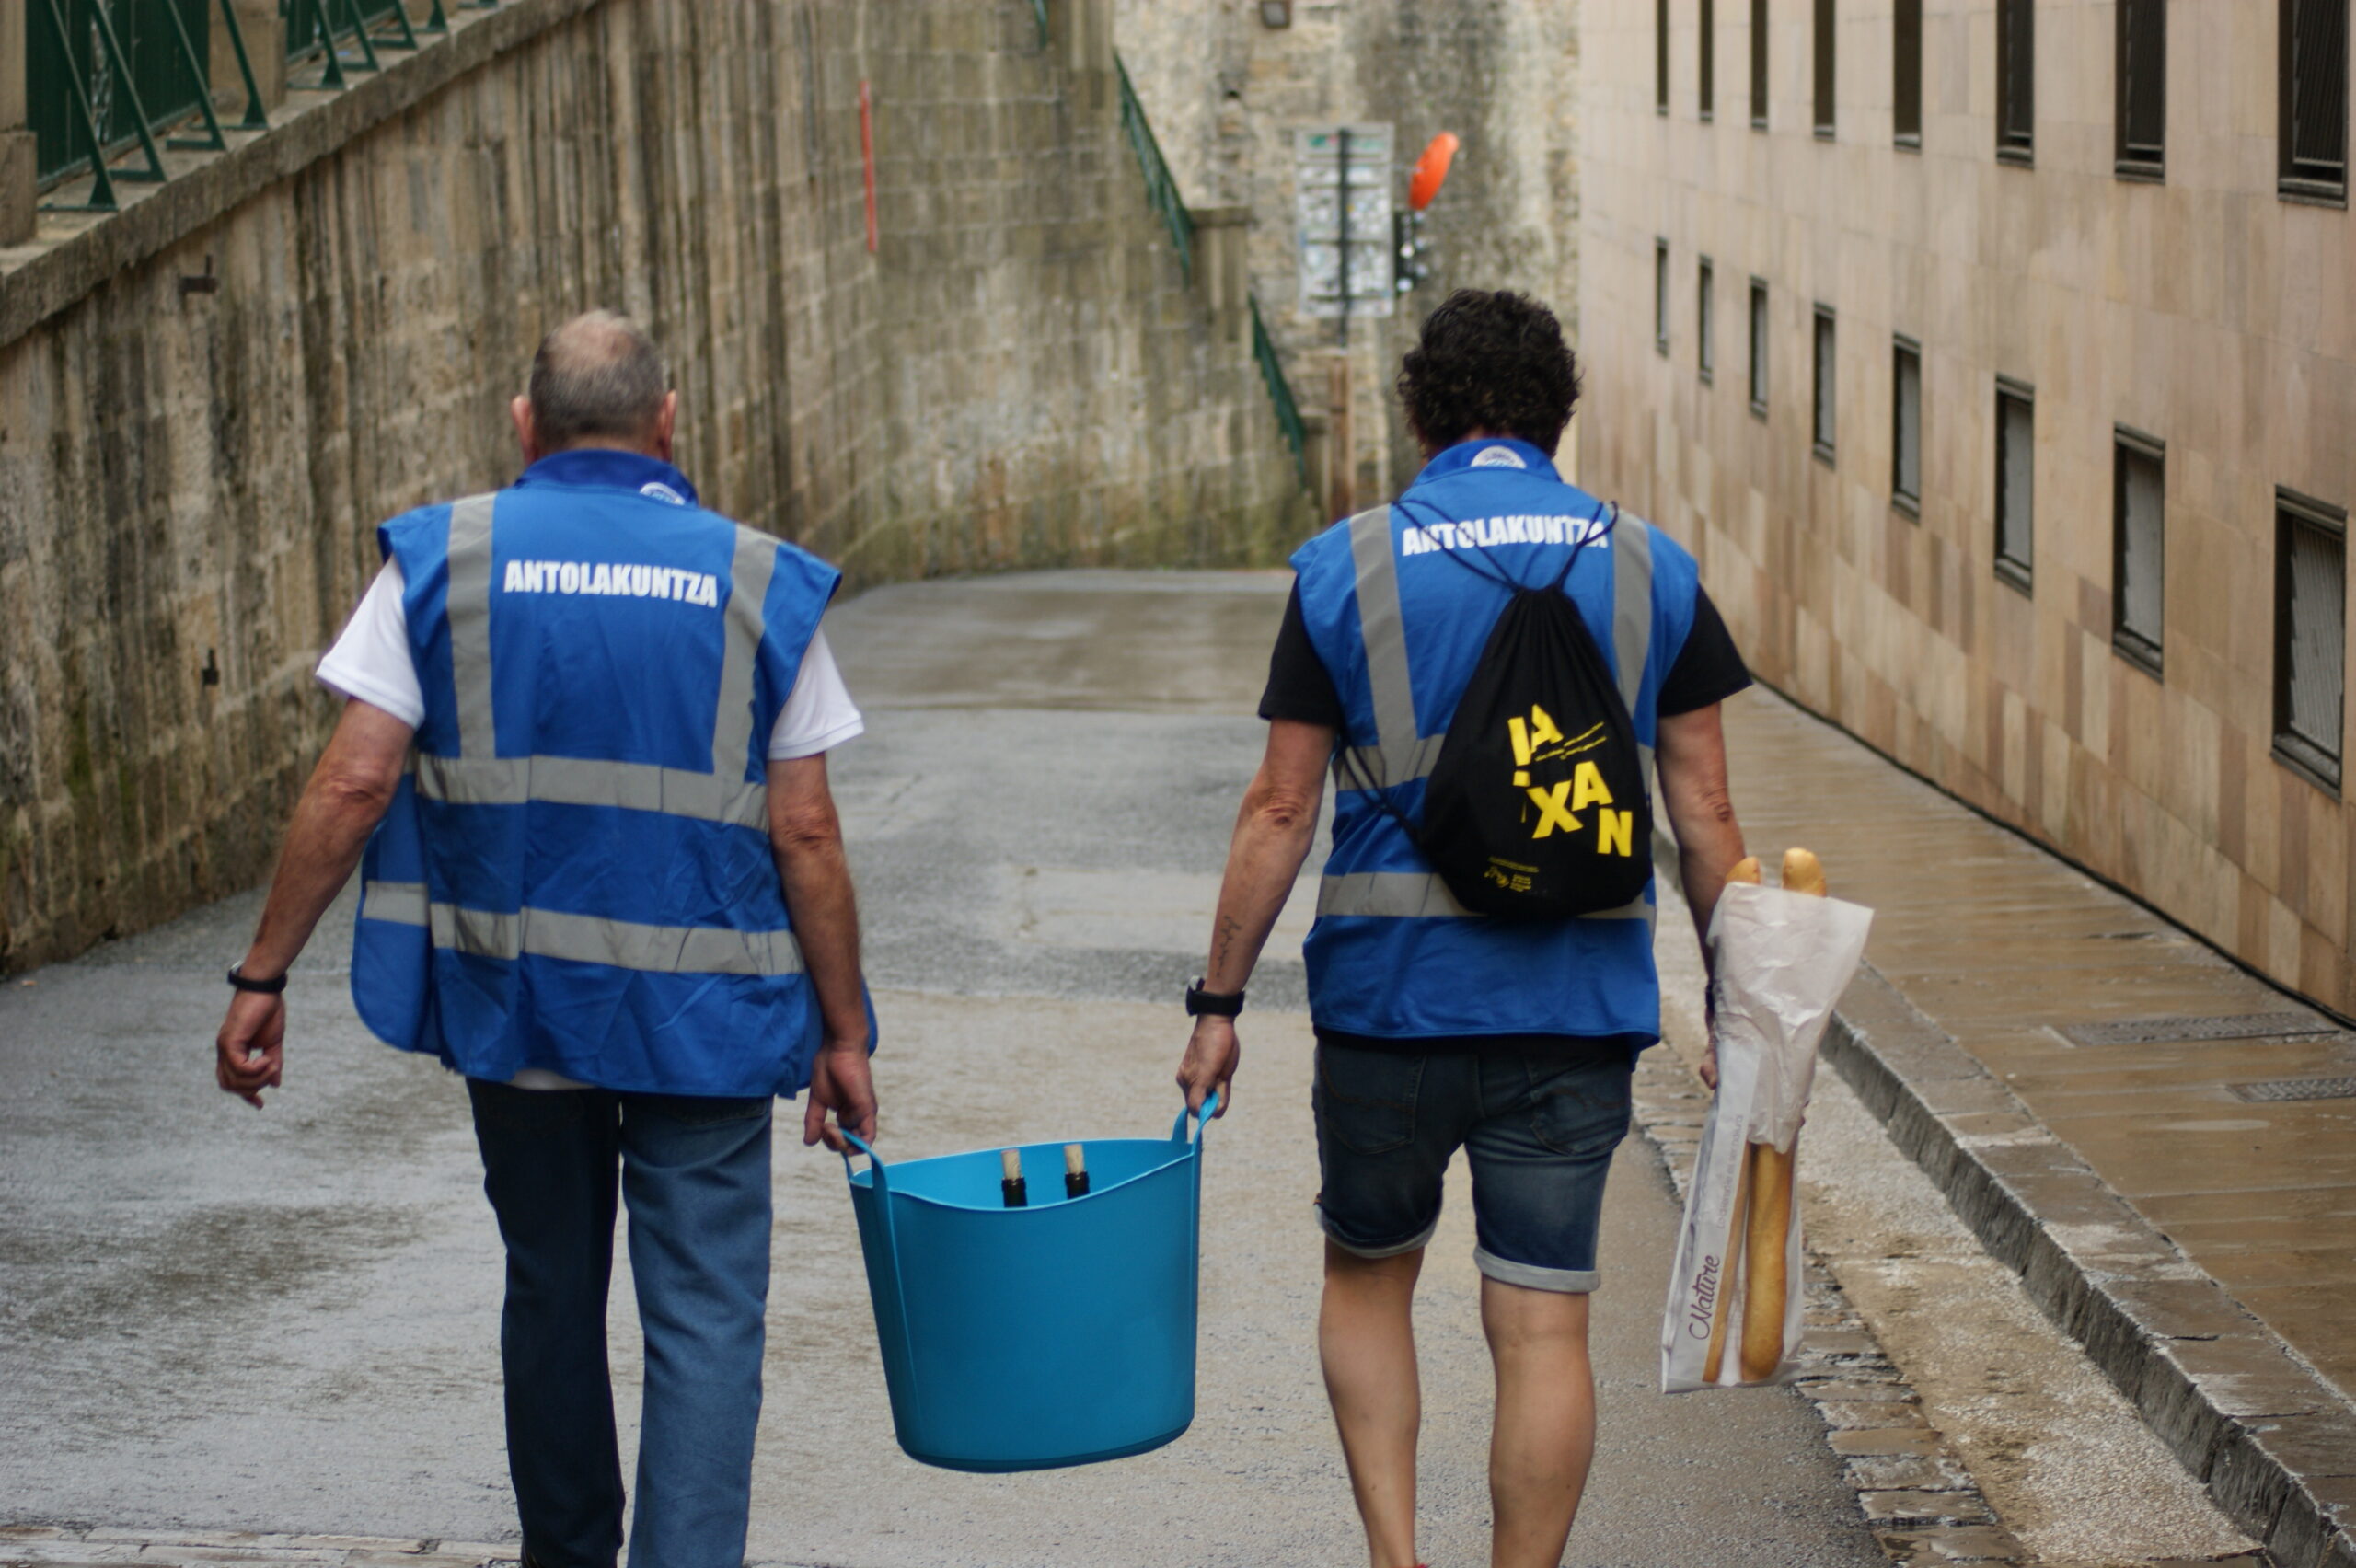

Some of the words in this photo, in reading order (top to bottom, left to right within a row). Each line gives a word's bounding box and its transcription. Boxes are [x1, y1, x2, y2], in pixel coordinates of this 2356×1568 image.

[1402, 515, 1609, 556] ANTOLAKUNTZA
[504, 559, 718, 608] ANTOLAKUNTZA
[1688, 1254, 1720, 1341] Nature
